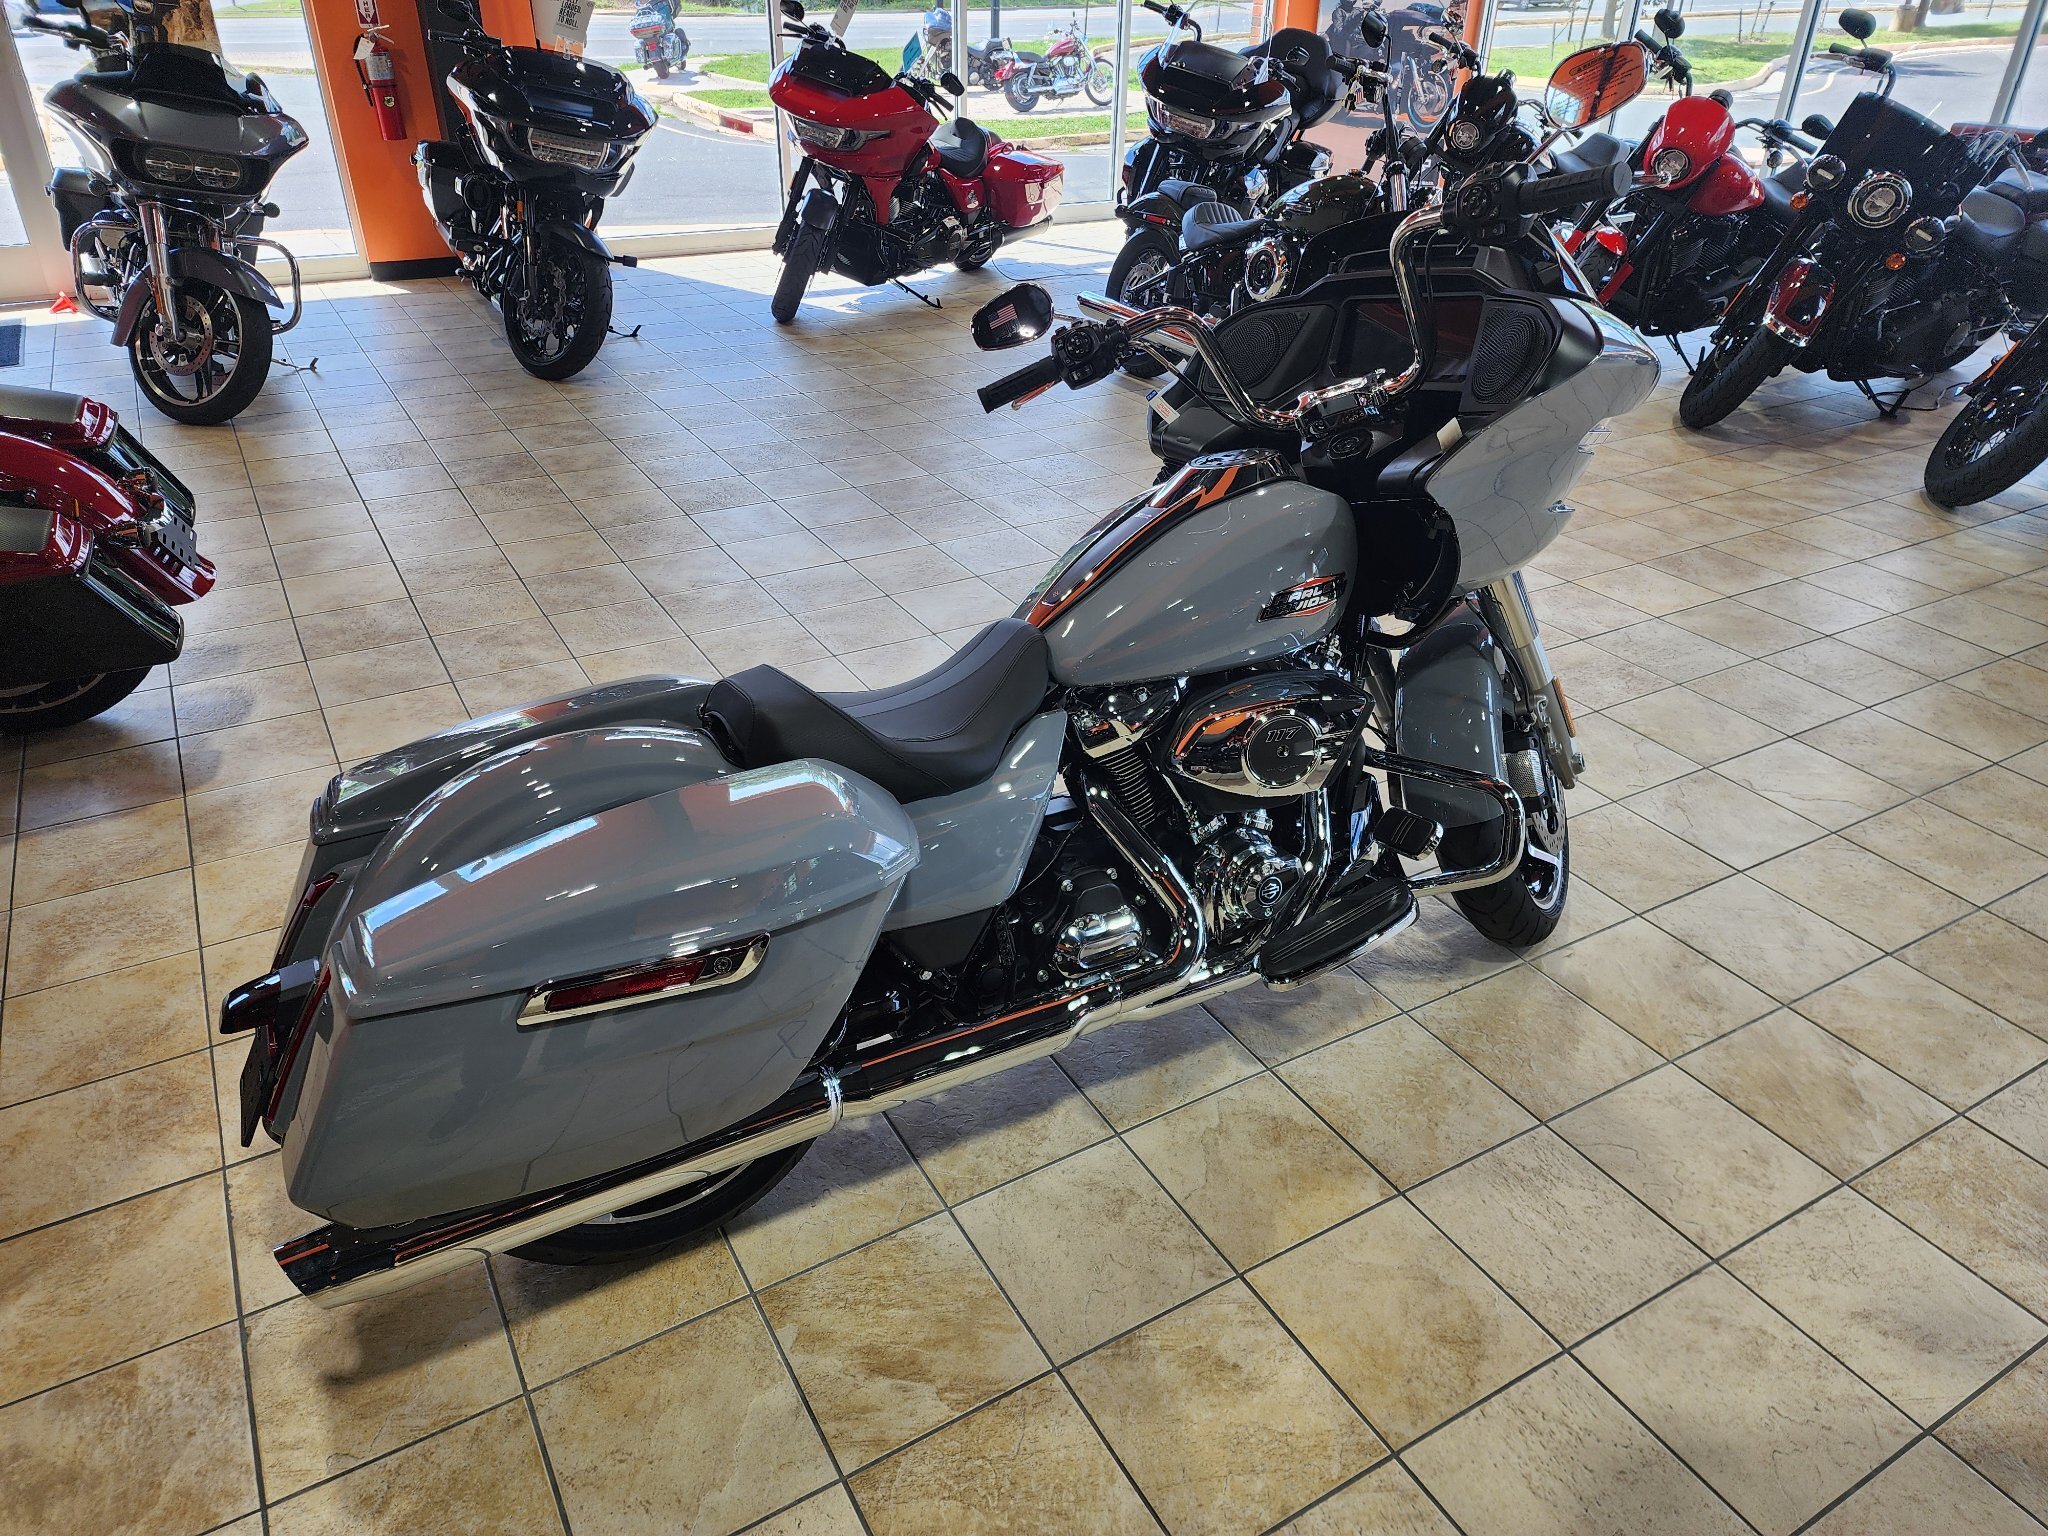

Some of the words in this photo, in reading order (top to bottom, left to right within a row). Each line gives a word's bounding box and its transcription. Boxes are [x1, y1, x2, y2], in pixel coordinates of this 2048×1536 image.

[559, 8, 576, 18] READY
[558, 15, 565, 23] TO
[1266, 725, 1302, 742] 117
